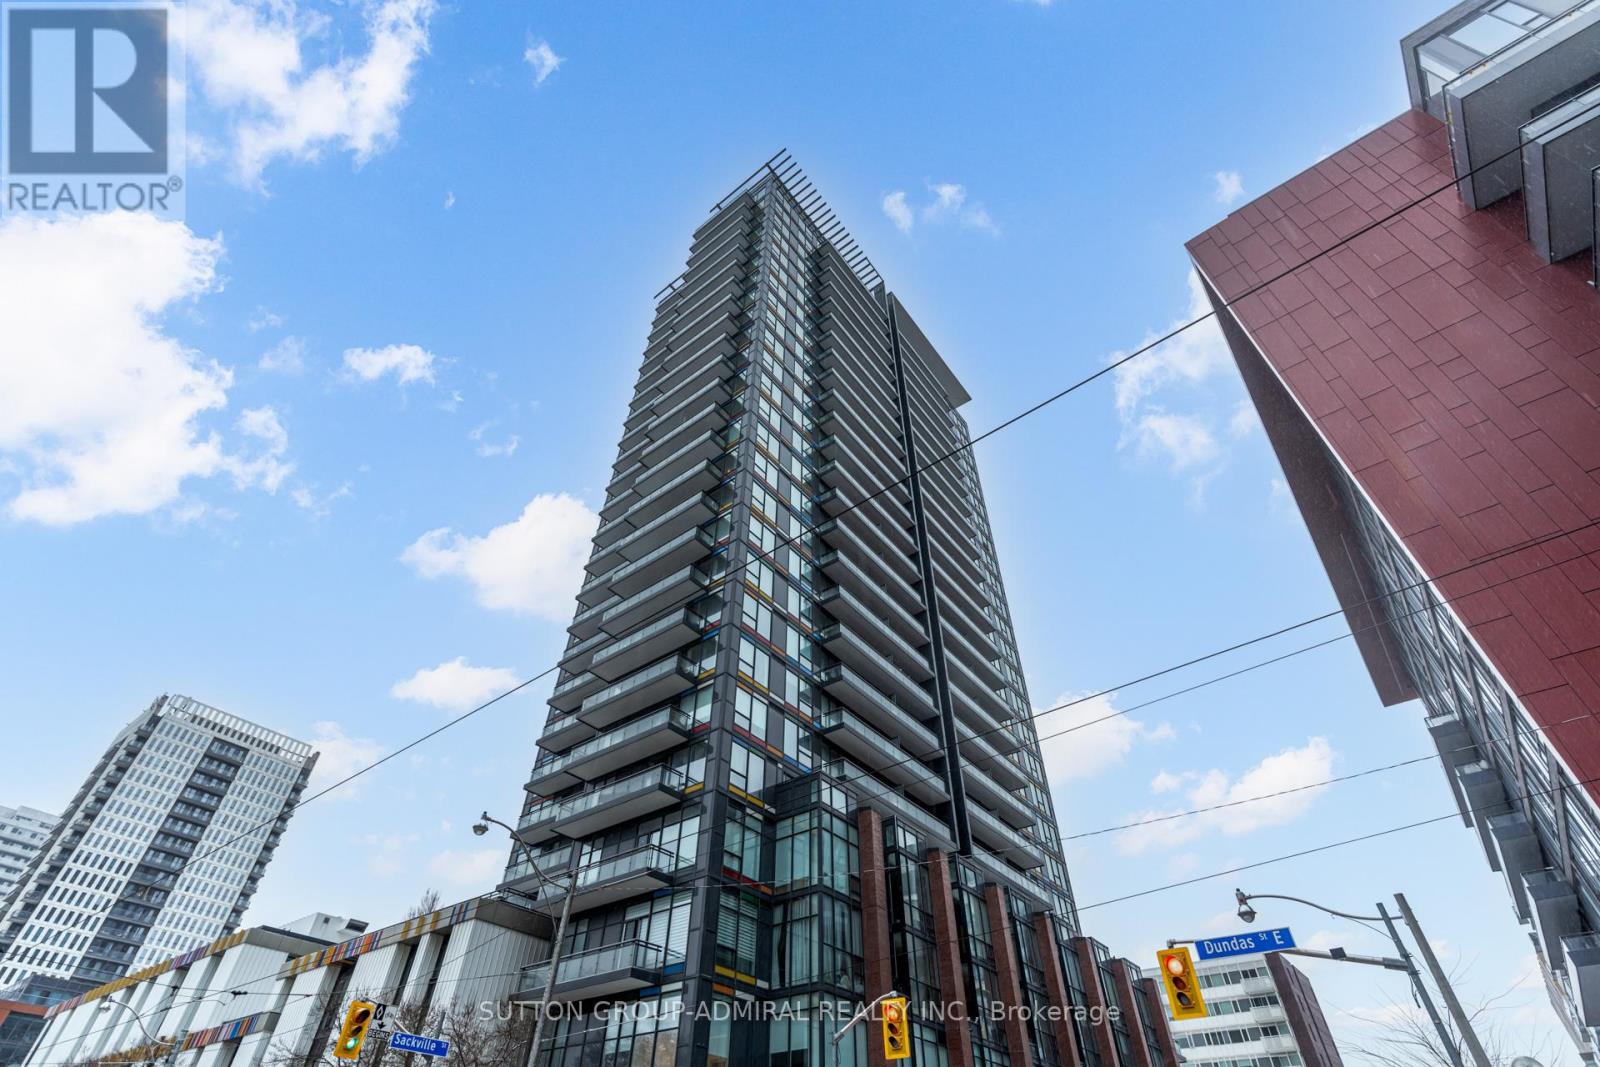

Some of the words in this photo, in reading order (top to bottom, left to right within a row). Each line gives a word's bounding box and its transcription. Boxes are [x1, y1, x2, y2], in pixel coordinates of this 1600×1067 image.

[1204, 937, 1255, 954] Dundas
[1272, 930, 1285, 945] E
[368, 1030, 390, 1040] BEGINS
[394, 1034, 436, 1051] Sackville
